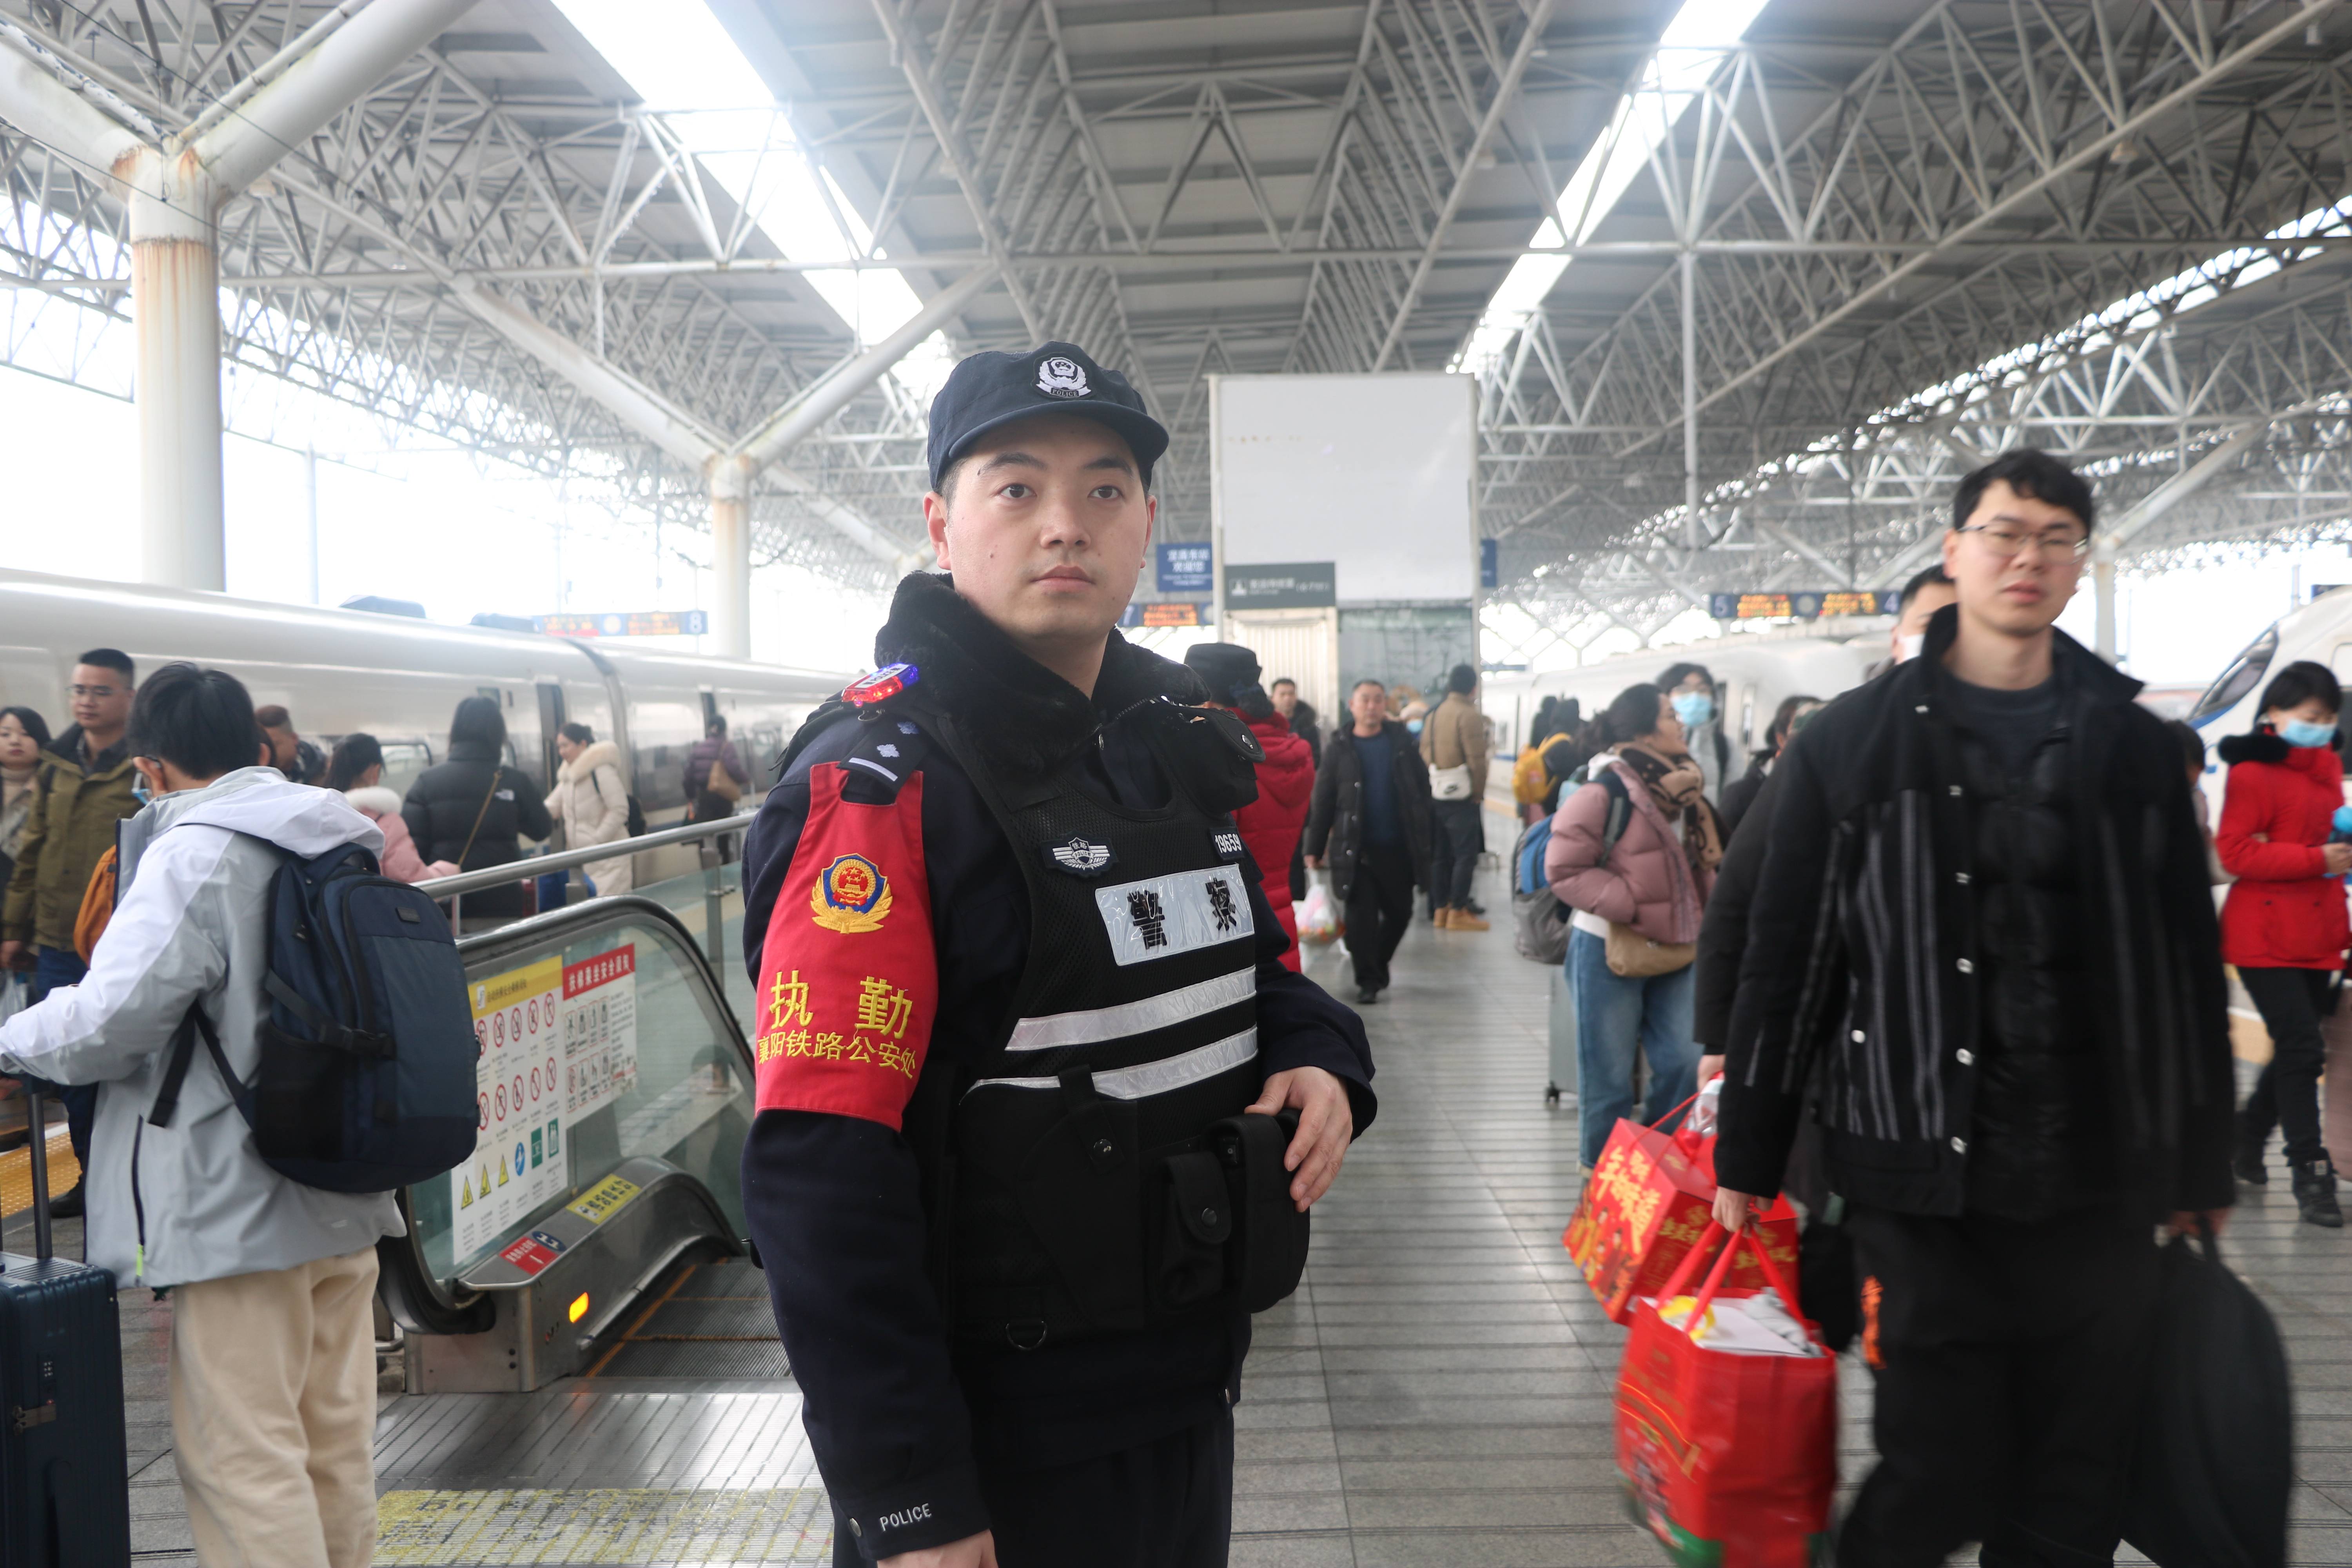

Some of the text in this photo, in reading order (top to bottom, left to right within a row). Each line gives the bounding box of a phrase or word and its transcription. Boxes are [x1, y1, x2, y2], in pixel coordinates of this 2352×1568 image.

[1884, 592, 1898, 613] 4
[689, 612, 702, 634] 8
[1072, 842, 1087, 850] 铁路
[769, 970, 913, 1039] 执勤
[757, 1029, 916, 1079] 襄阳铁路公安处
[880, 1503, 932, 1532] POLICE
